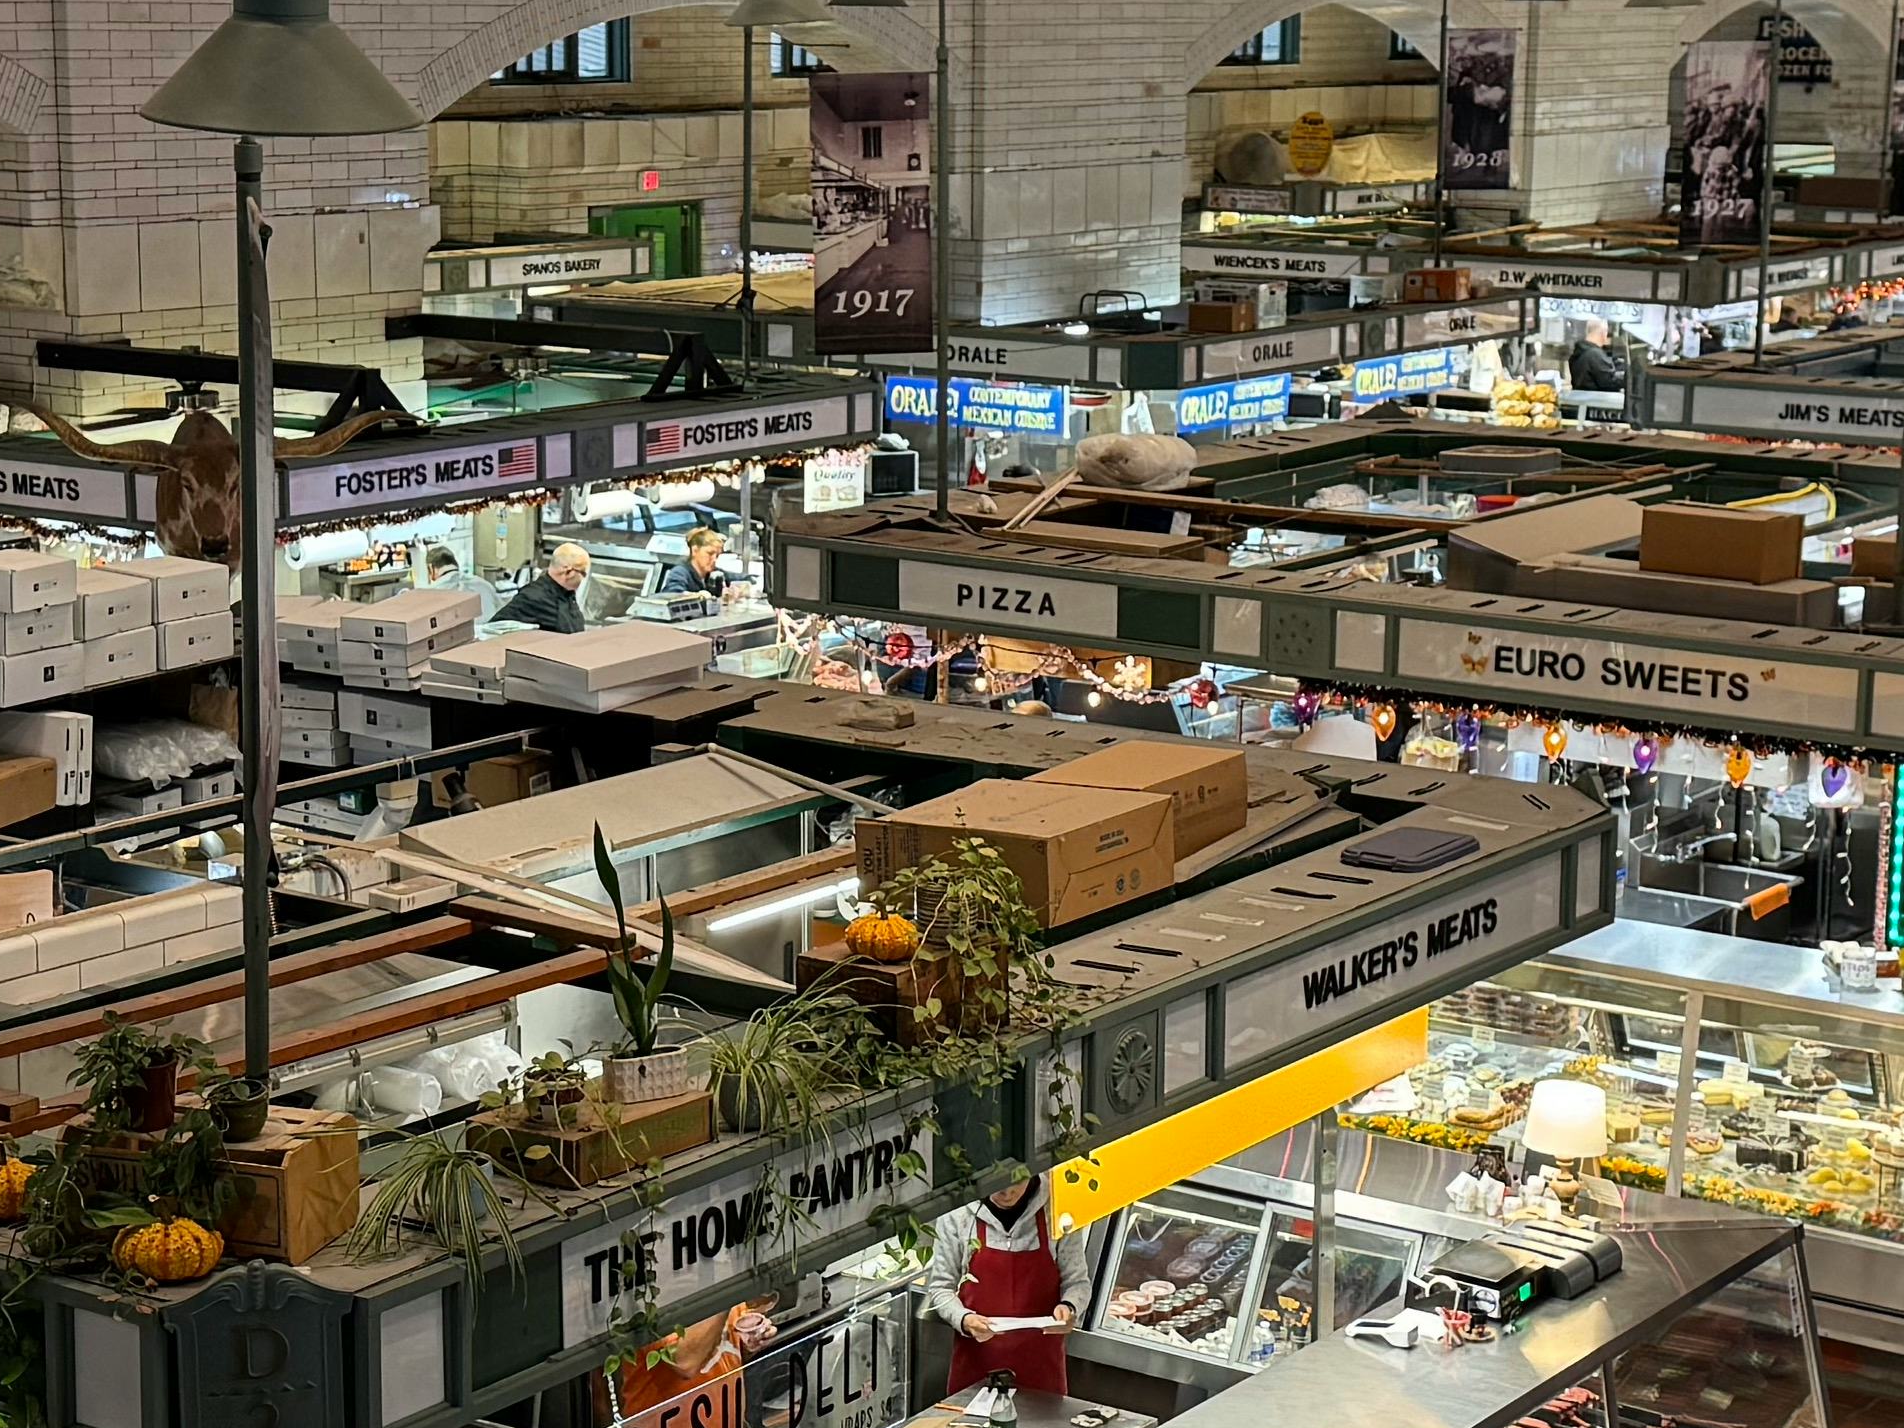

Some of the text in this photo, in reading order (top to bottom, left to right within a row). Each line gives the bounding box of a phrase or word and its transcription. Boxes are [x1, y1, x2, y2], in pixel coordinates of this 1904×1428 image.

[1763, 21, 1806, 37] FSH
[1691, 197, 1754, 221] 1927
[522, 255, 602, 276] SPANOS BAKERY
[1214, 254, 1326, 273] WIENCEK'S MEATS
[1499, 270, 1603, 289] D.W. WHITAKER
[831, 288, 915, 319] 1917
[1252, 340, 1294, 363] ORALE
[682, 411, 813, 449] FOSTER'S MEATS
[1778, 402, 1904, 428] JIM'S MEATS
[11, 471, 81, 502] MEATS
[334, 453, 494, 498] FOSTER'S MEATS
[956, 582, 1057, 617] PIZZA
[1493, 644, 1751, 703] EURO SWEETS
[1303, 897, 1499, 1011] WALKER'S MEATS
[584, 1133, 922, 1305] THE HOME PANTRY
[238, 1325, 291, 1380] D
